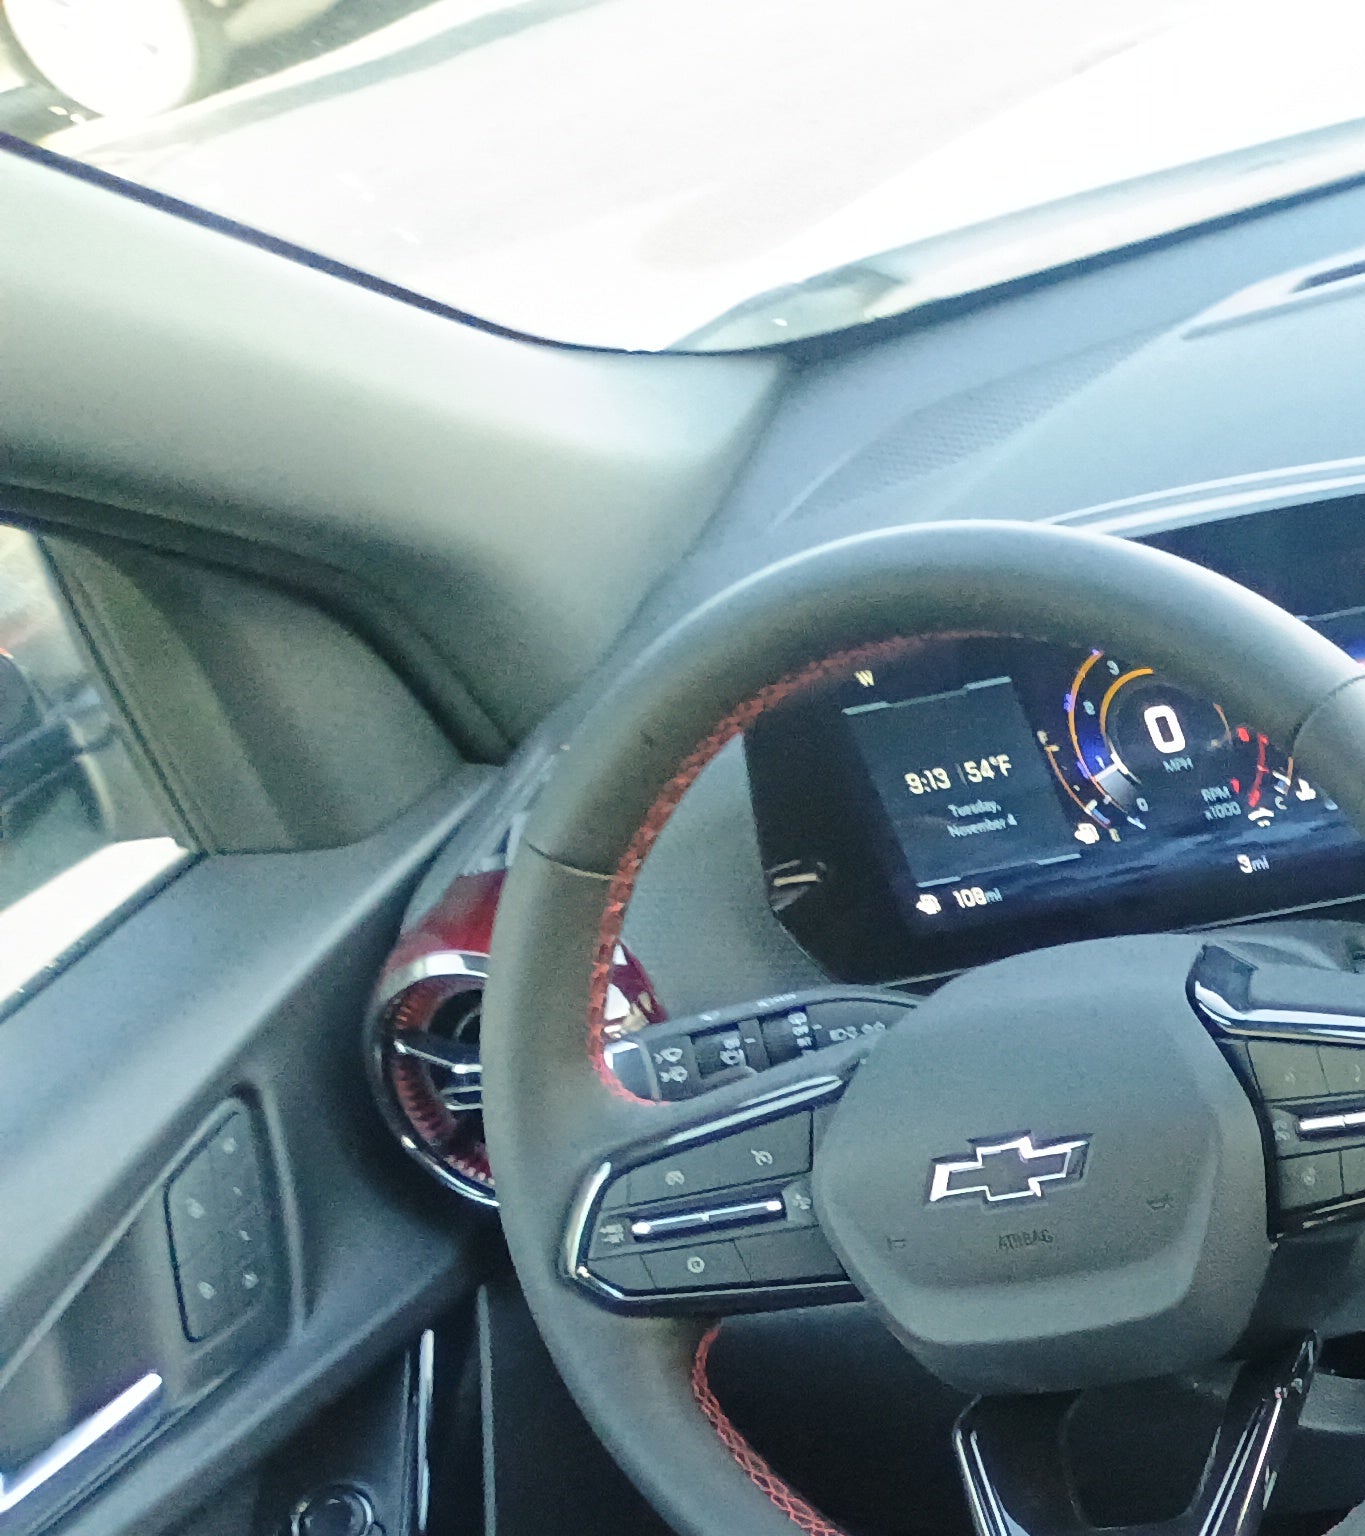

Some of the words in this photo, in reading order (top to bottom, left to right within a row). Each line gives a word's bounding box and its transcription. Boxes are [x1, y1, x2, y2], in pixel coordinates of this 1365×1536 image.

[854, 669, 875, 687] W
[1143, 704, 1186, 754] 0
[963, 753, 1012, 783] 54°F
[1201, 786, 1231, 803] RPM
